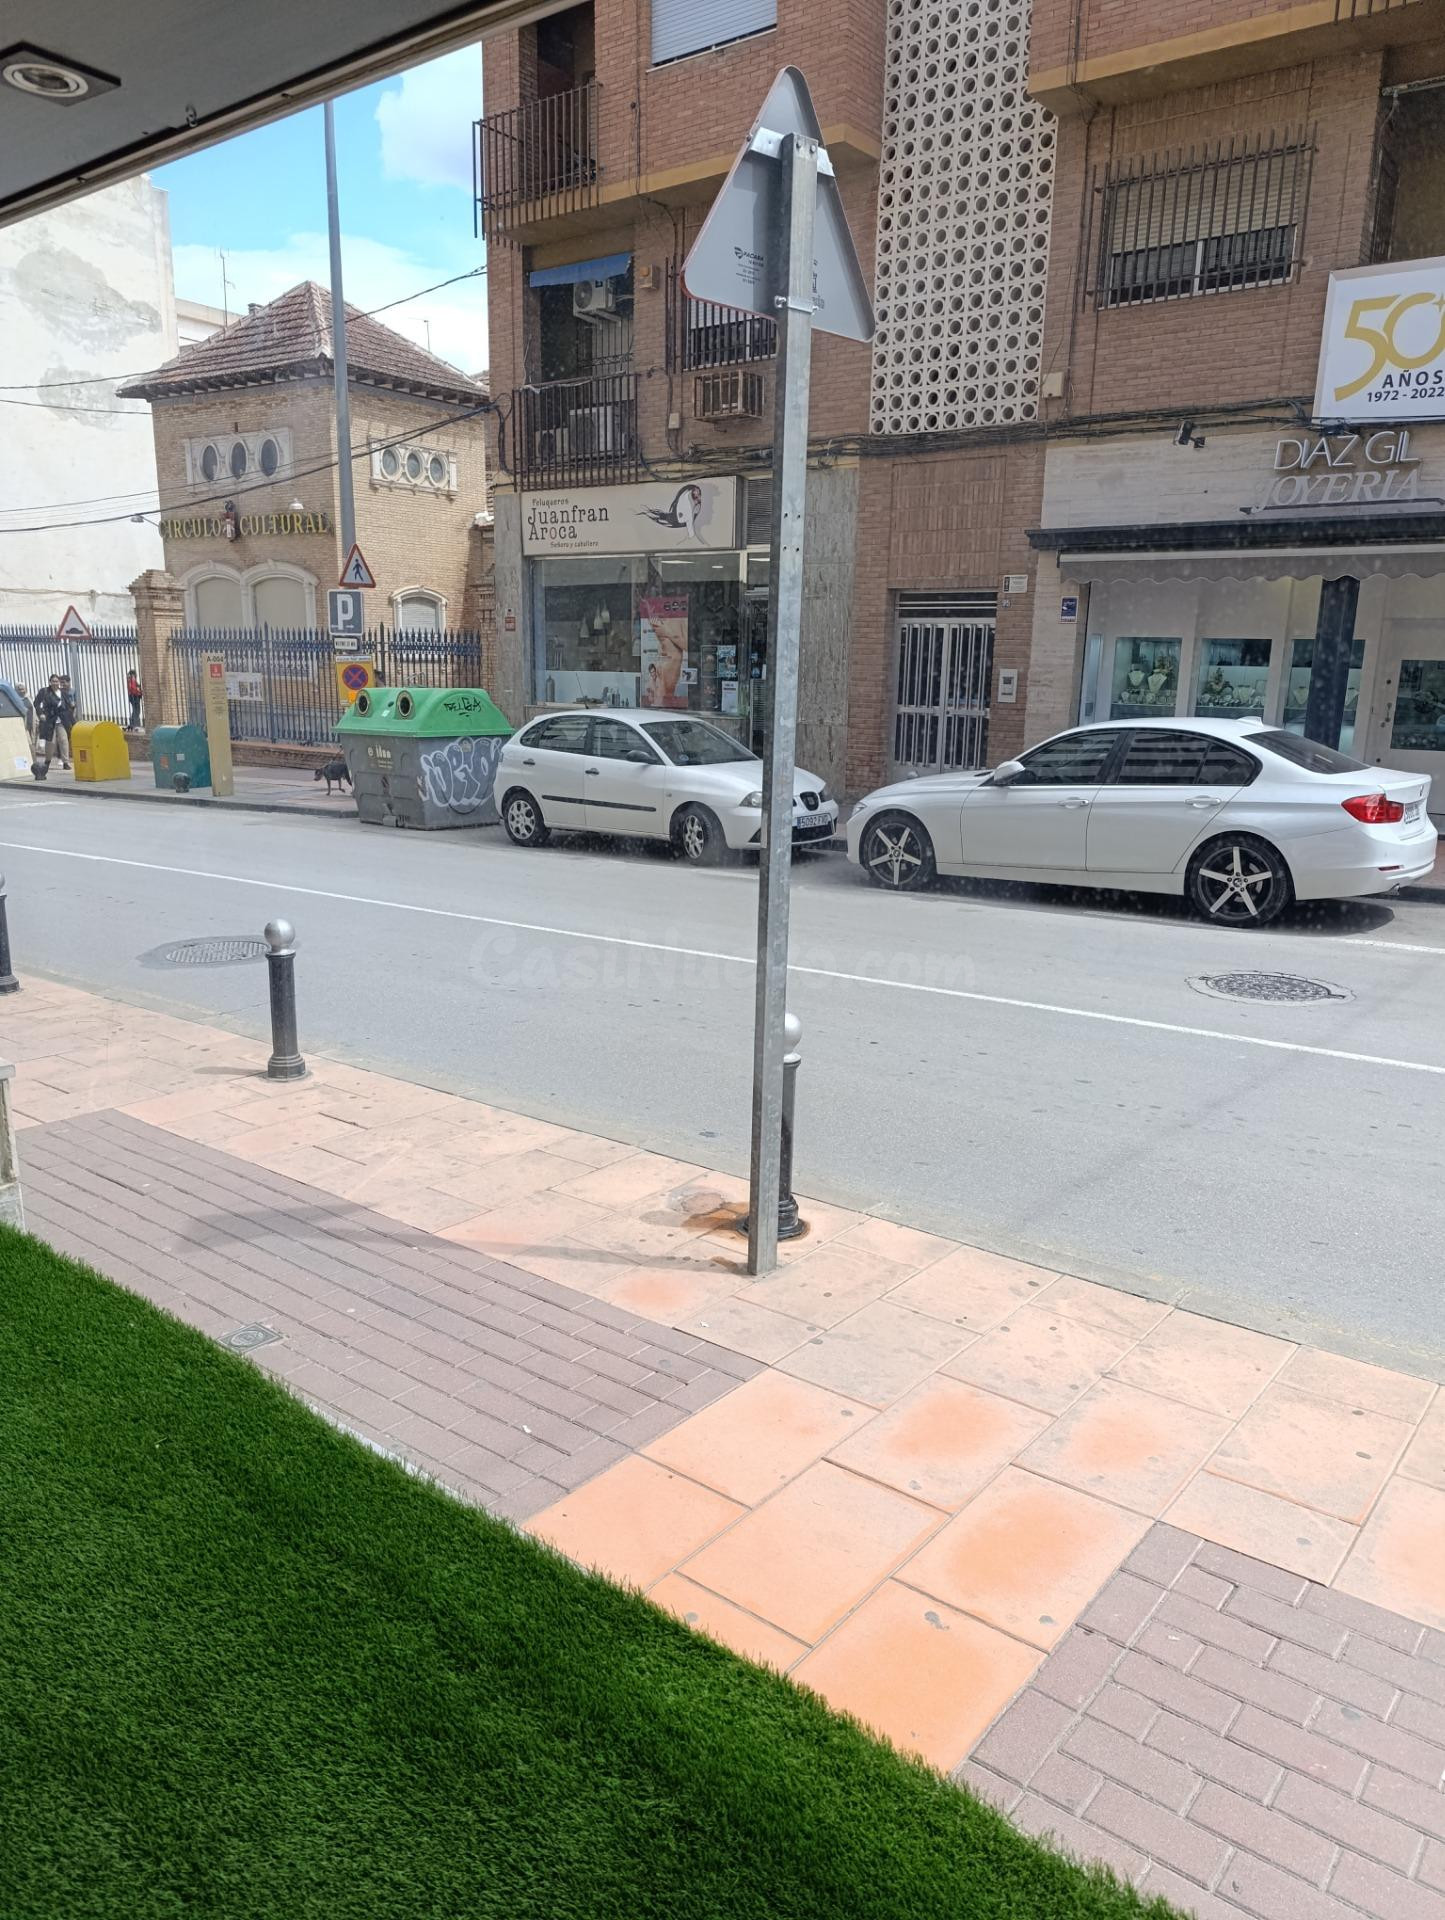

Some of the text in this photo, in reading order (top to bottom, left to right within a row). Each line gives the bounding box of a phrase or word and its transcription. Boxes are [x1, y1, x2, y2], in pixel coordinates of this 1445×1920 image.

[1334, 292, 1445, 402] 50
[1382, 369, 1443, 389] AÑOS
[1367, 390, 1399, 402] 1972
[1410, 387, 1445, 399] 2022
[1274, 430, 1419, 469] DIAZ GIL
[1250, 469, 1419, 513] JOYERIA
[159, 512, 328, 538] CIRCULO CULTURAL
[528, 505, 609, 525] Juanfran
[528, 524, 577, 540] Aroca
[337, 594, 353, 630] P
